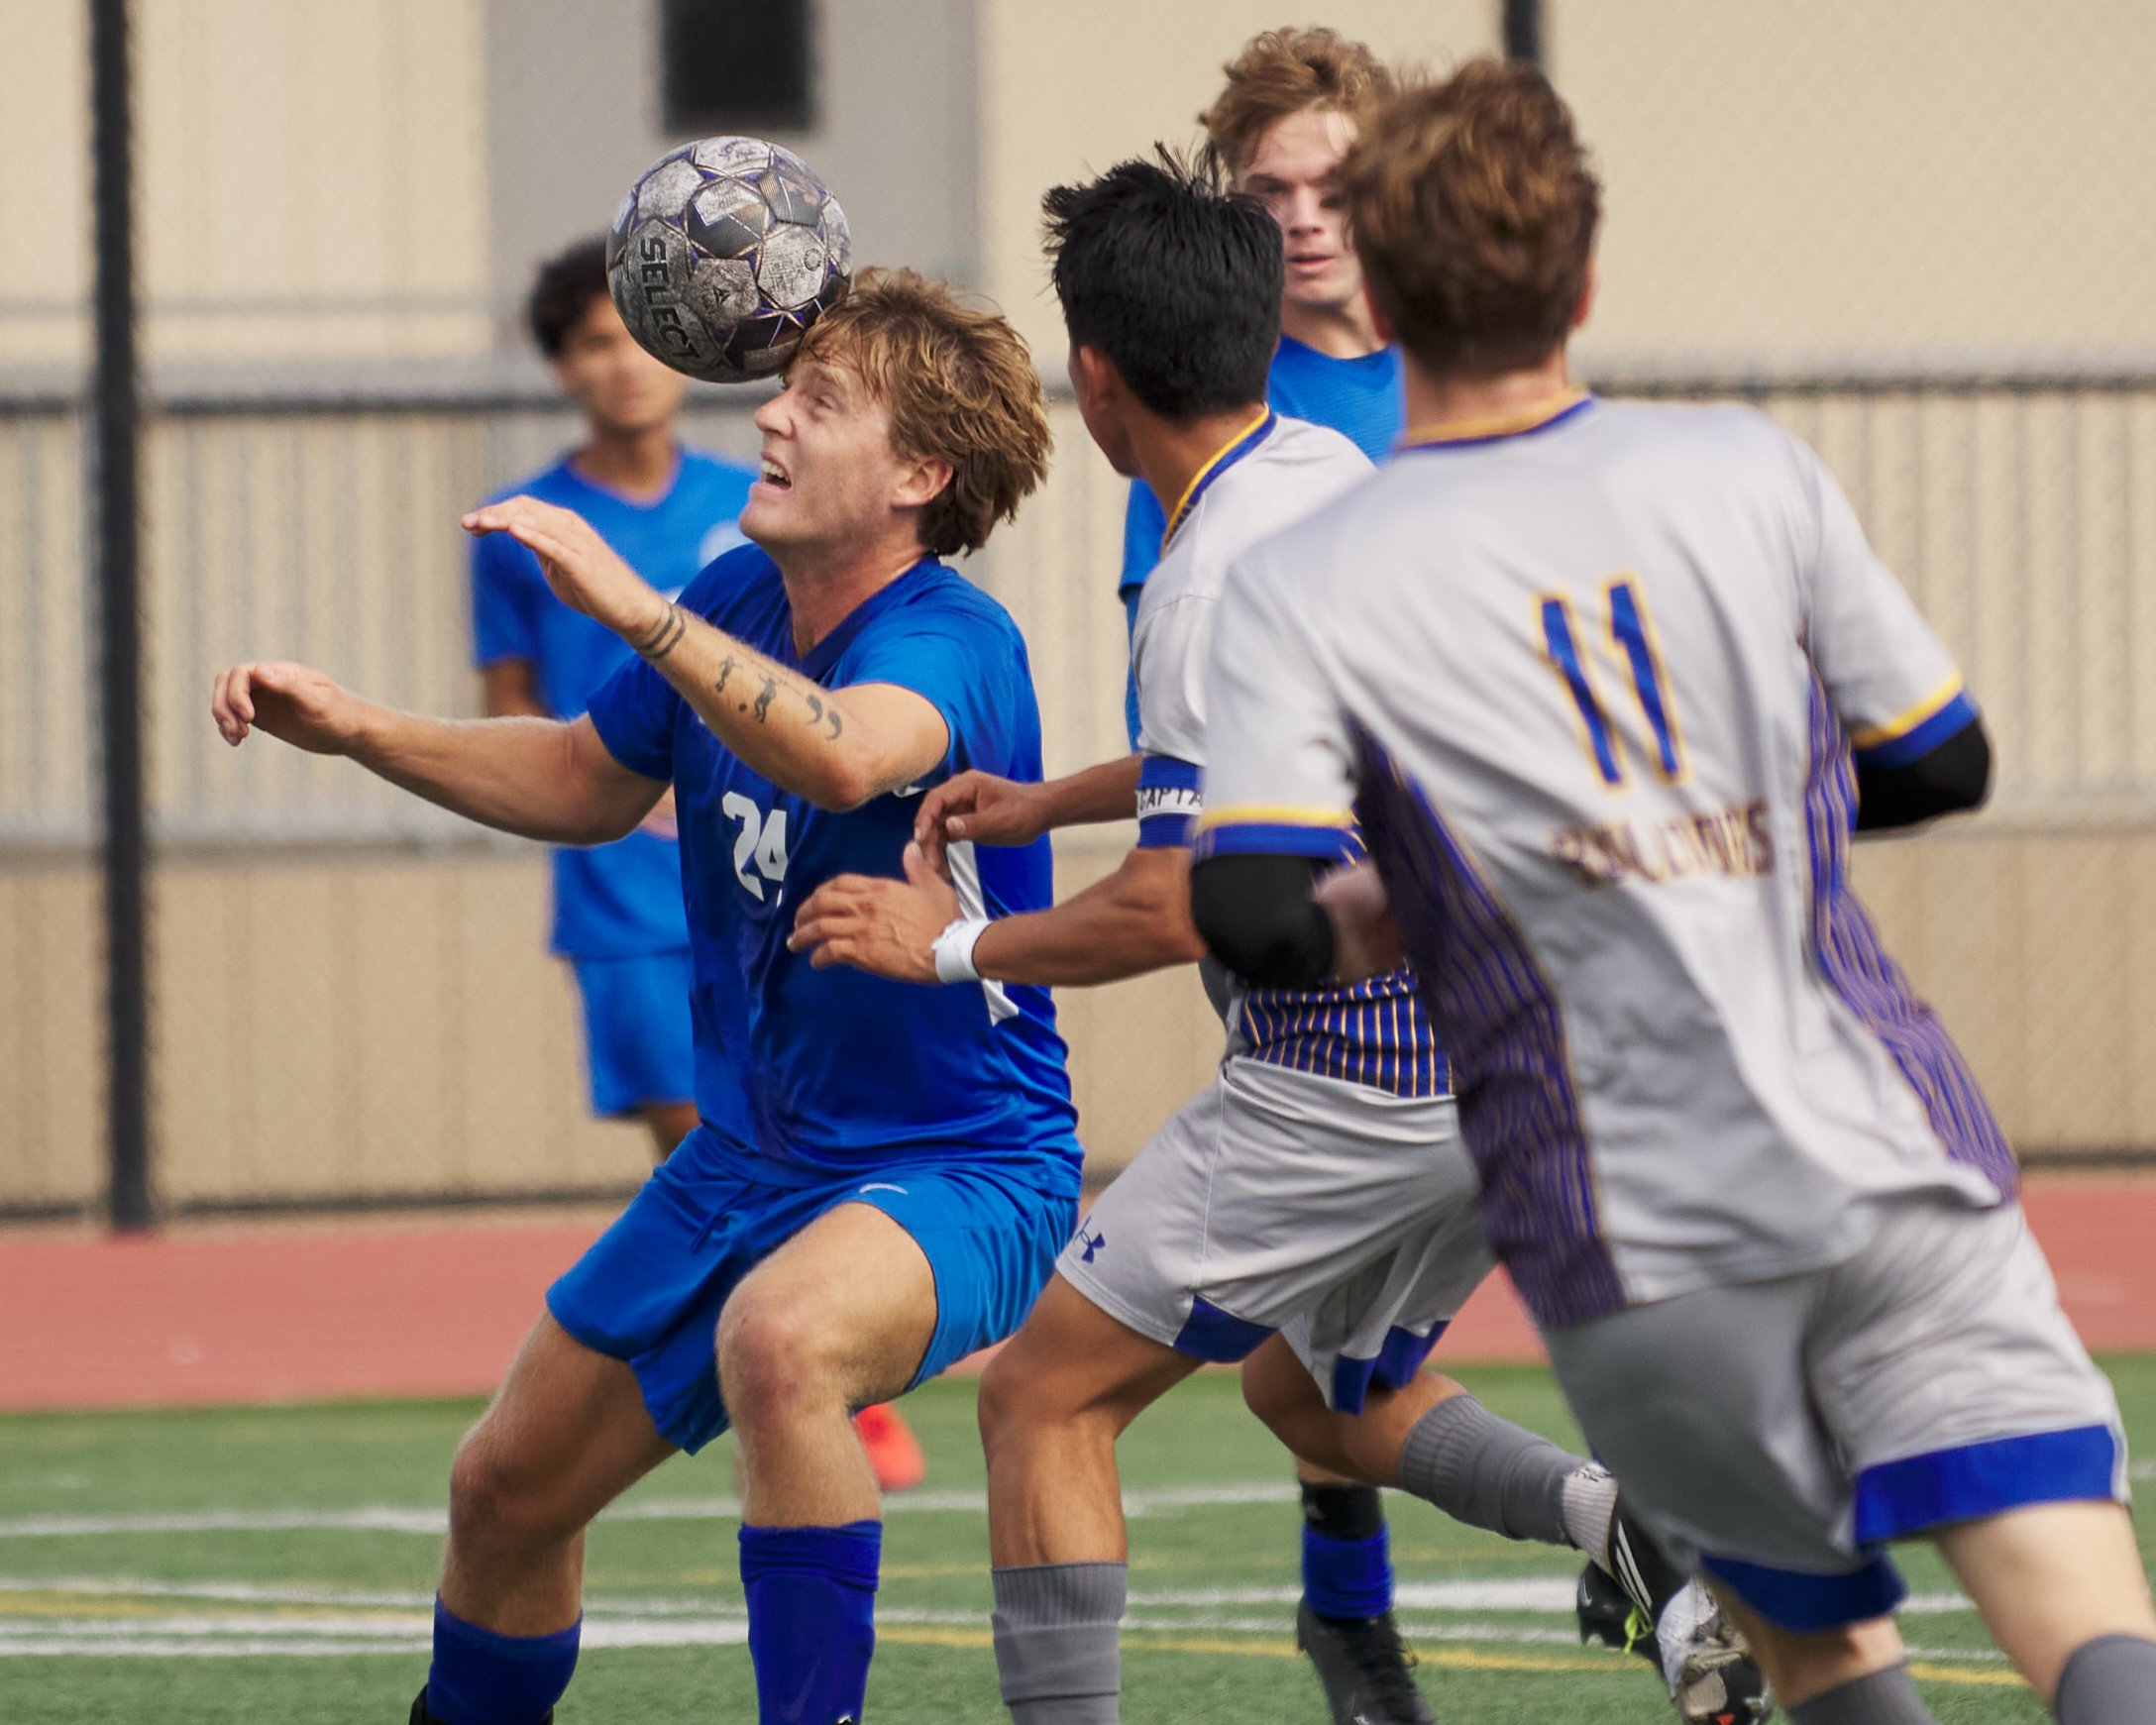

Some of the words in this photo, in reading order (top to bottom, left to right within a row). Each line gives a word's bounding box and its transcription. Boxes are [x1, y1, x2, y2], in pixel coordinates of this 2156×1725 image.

[640, 237, 701, 359] SELECT
[1533, 572, 1692, 795] 11
[721, 791, 789, 909] 24
